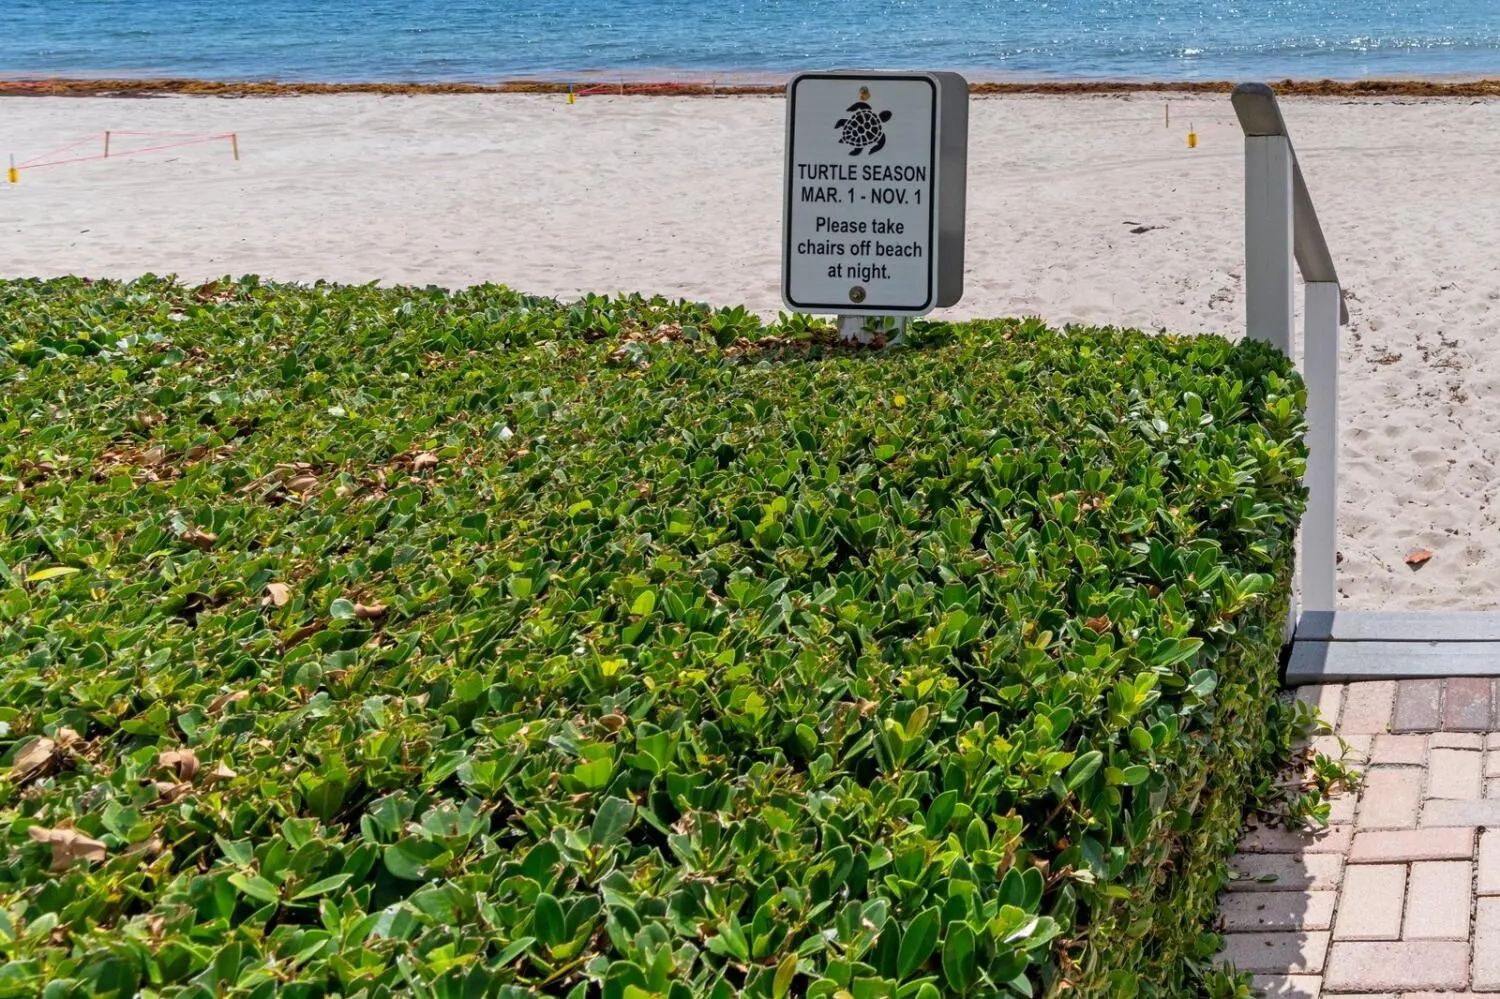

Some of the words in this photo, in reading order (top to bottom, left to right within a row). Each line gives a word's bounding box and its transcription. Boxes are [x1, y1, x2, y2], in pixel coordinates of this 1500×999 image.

[798, 163, 857, 181] TURTLE
[862, 165, 926, 182] SEASON
[801, 187, 842, 203] MAR.
[848, 188, 854, 203] 1
[871, 189, 909, 204] NOV.
[915, 189, 921, 205] 1
[815, 217, 867, 233] Please
[872, 218, 904, 235] take
[798, 239, 845, 255] chairs
[850, 240, 871, 256] off
[876, 241, 922, 257] beach
[828, 263, 843, 278] at
[847, 263, 891, 283] night.
